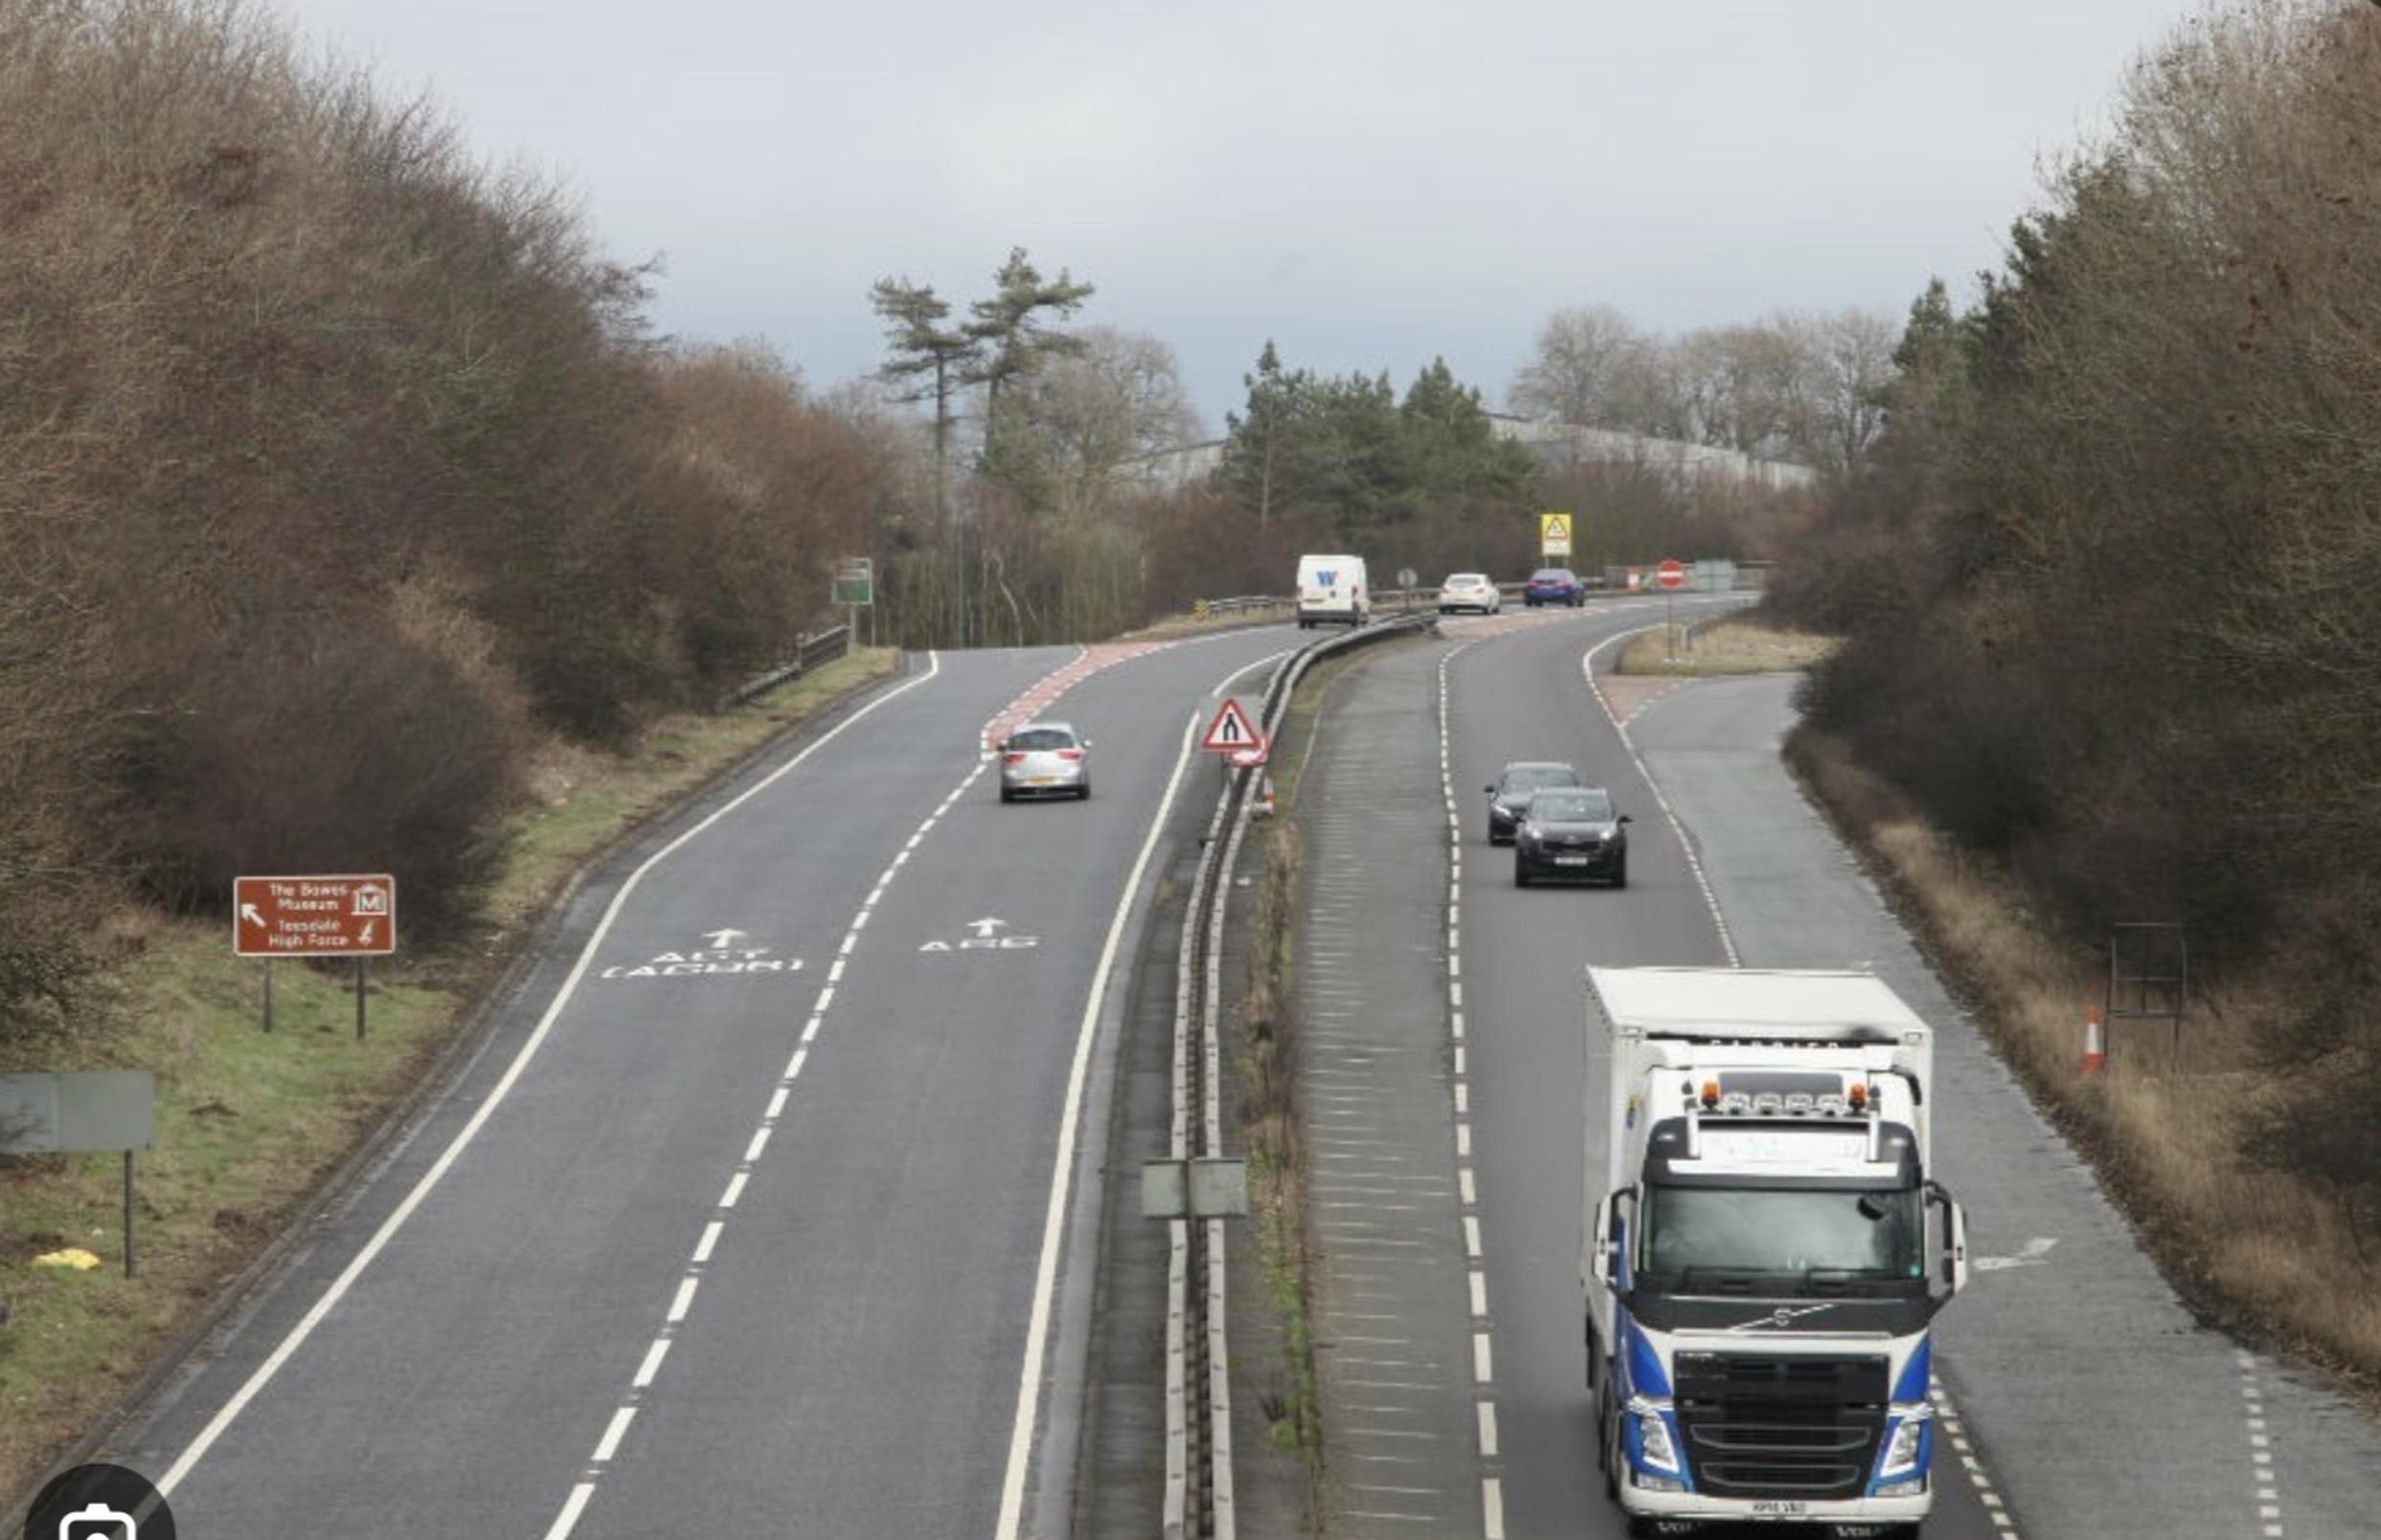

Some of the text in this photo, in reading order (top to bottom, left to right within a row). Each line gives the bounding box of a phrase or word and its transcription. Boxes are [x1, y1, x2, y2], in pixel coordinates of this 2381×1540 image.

[269, 883, 348, 897] The Bowes
[277, 899, 339, 911] Museum
[268, 934, 349, 949] High Force
